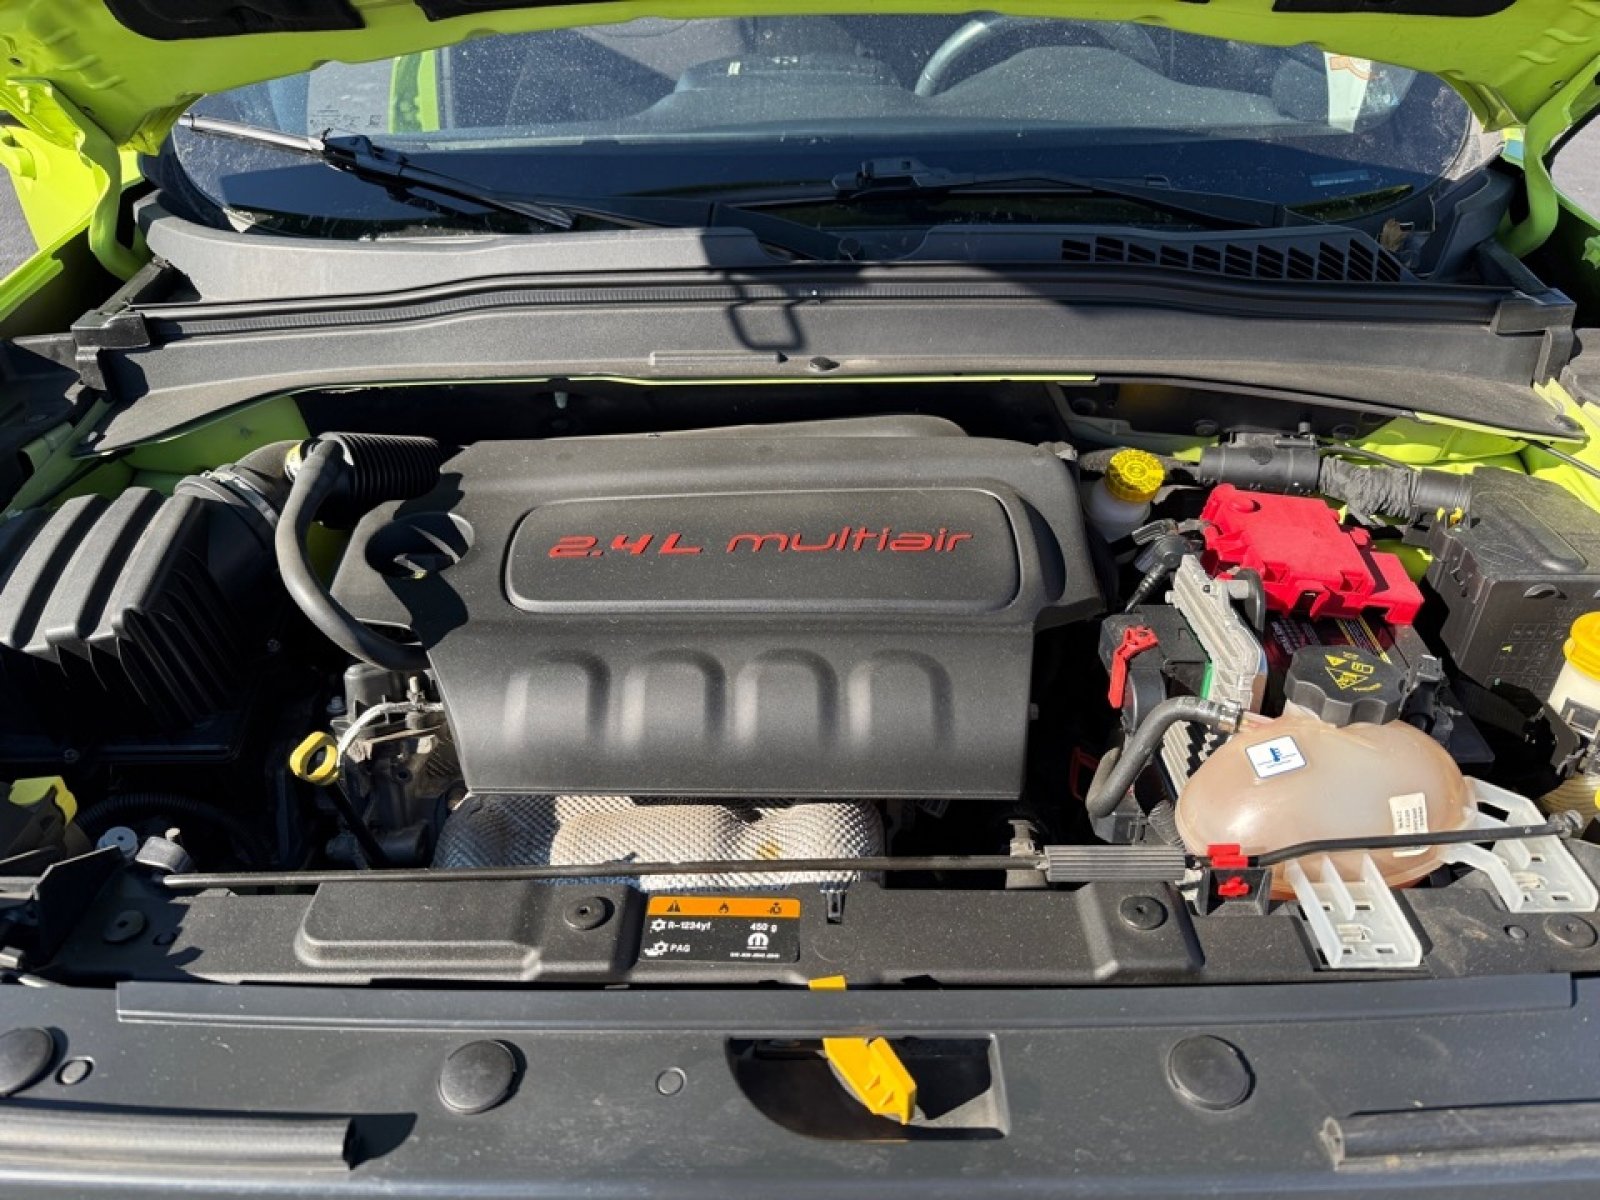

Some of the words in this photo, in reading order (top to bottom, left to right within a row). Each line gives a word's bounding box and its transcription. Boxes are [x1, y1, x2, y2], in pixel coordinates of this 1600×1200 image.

[726, 525, 975, 553] multiair
[749, 922, 767, 931] 450
[770, 924, 777, 933] g
[669, 944, 690, 953] PAG
